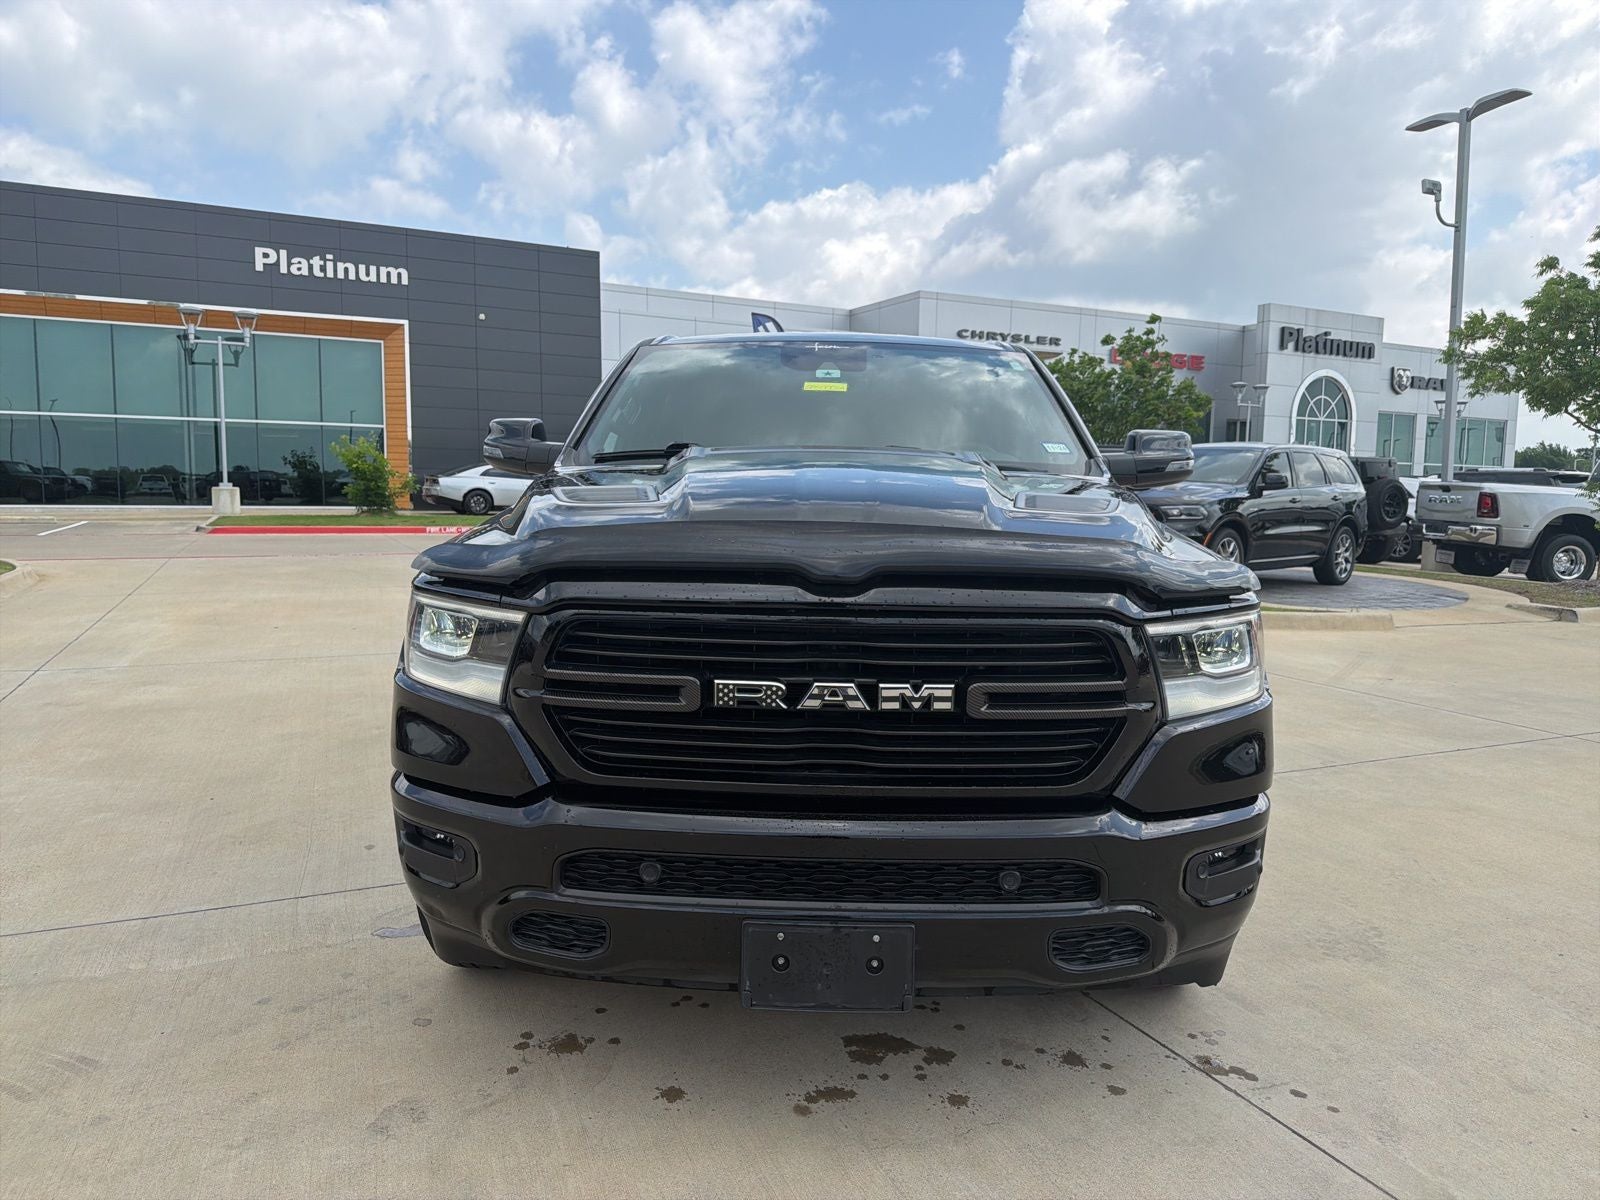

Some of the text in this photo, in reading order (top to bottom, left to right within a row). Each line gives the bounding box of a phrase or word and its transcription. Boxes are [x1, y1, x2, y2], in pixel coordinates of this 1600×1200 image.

[254, 246, 409, 286] Platinum
[956, 329, 1062, 347] CHRYSLER
[1280, 326, 1376, 360] Platinum
[1411, 376, 1447, 391] RA
[1428, 495, 1462, 504] RAM
[714, 679, 956, 712] RAM
